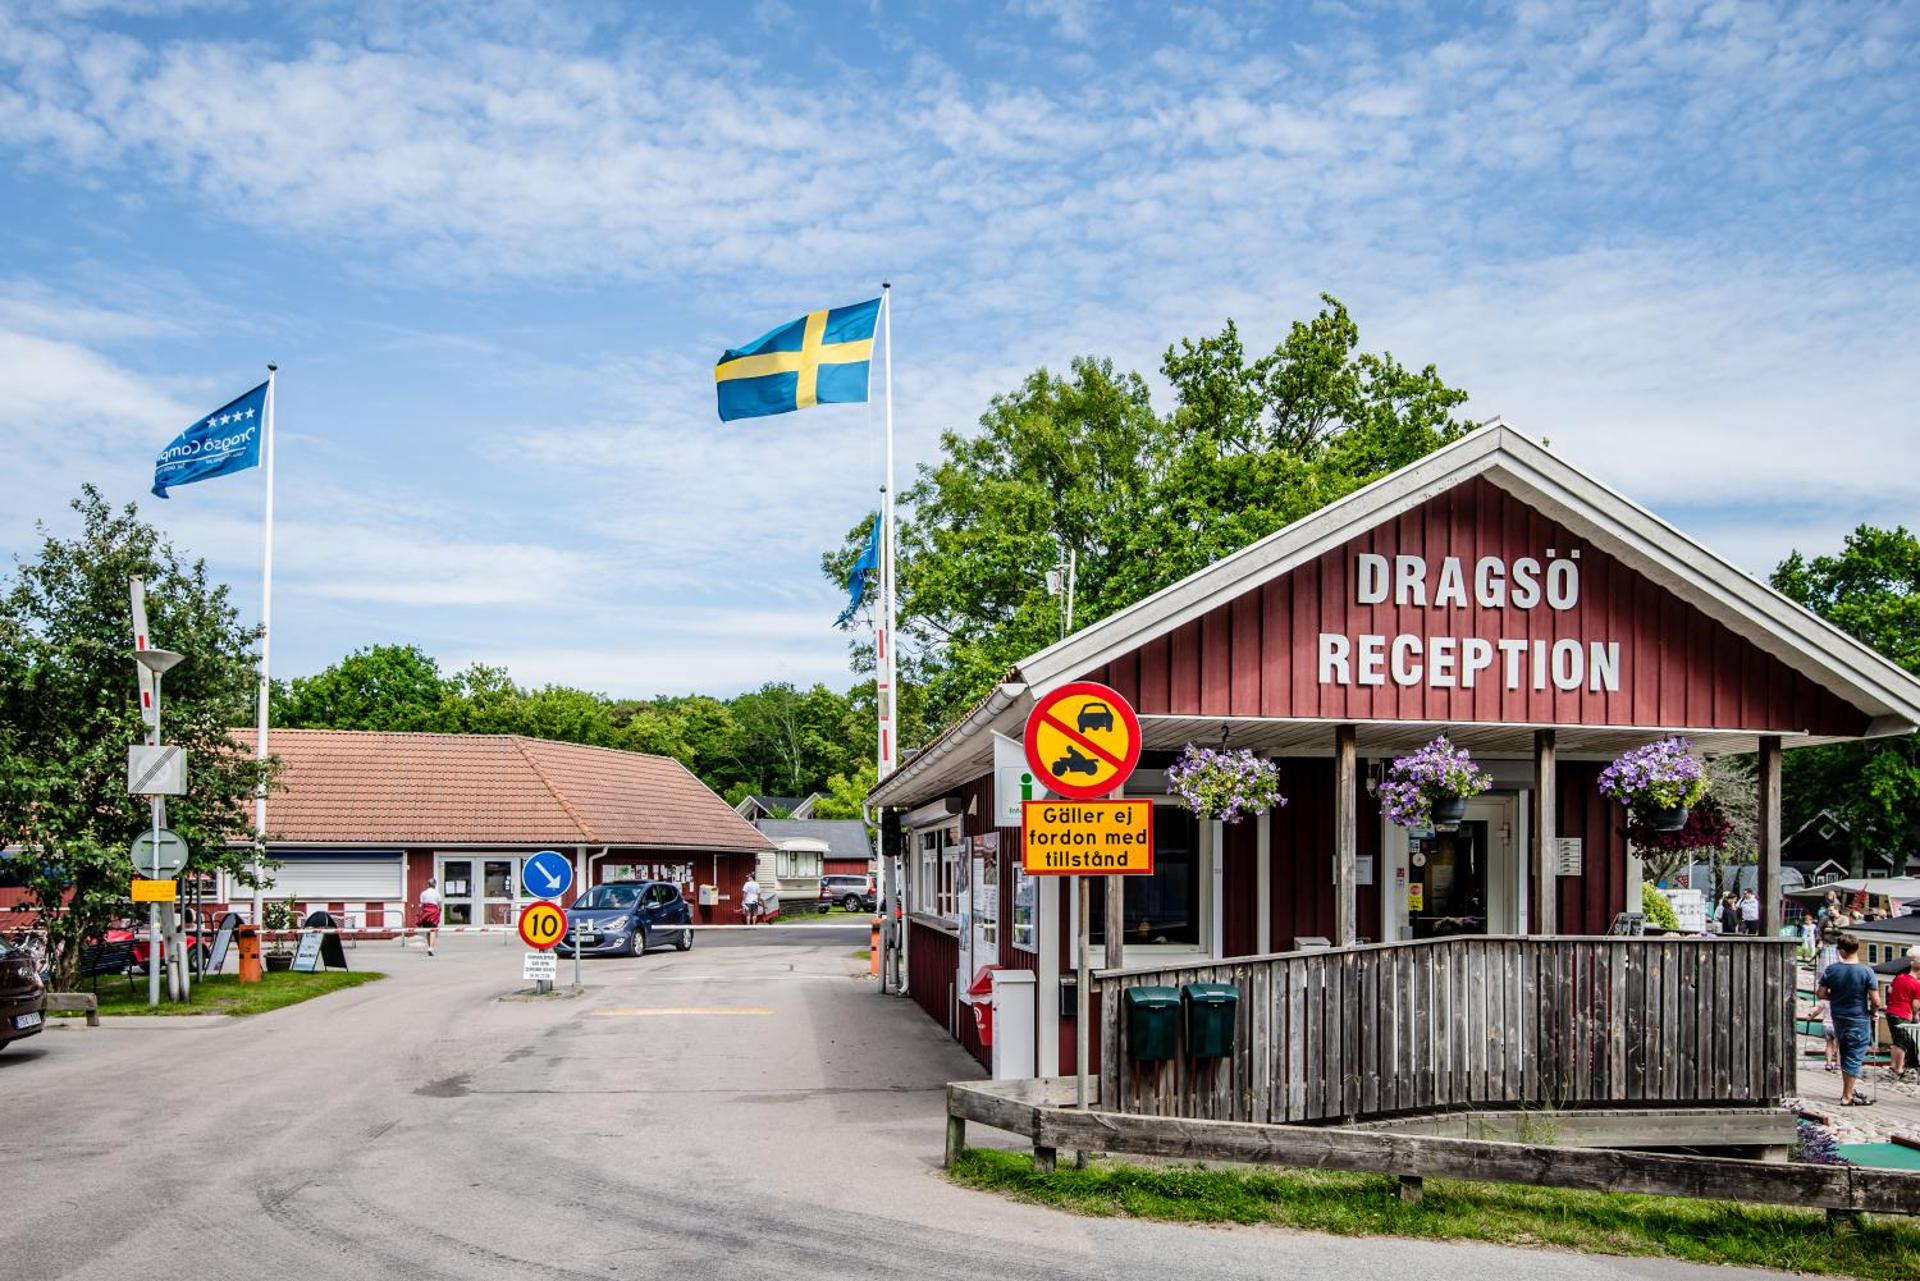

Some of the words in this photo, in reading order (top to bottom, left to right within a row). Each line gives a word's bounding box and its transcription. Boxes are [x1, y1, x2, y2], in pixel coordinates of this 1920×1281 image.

[1358, 549, 1580, 610] DRAGSÖ
[1318, 633, 1620, 692] RECEPTION
[1043, 807, 1104, 824] Gäller
[1114, 807, 1132, 826] ej
[1029, 829, 1097, 845] fordon
[1105, 829, 1147, 845] med
[1045, 851, 1129, 867] tillstånd
[532, 913, 558, 937] 10
